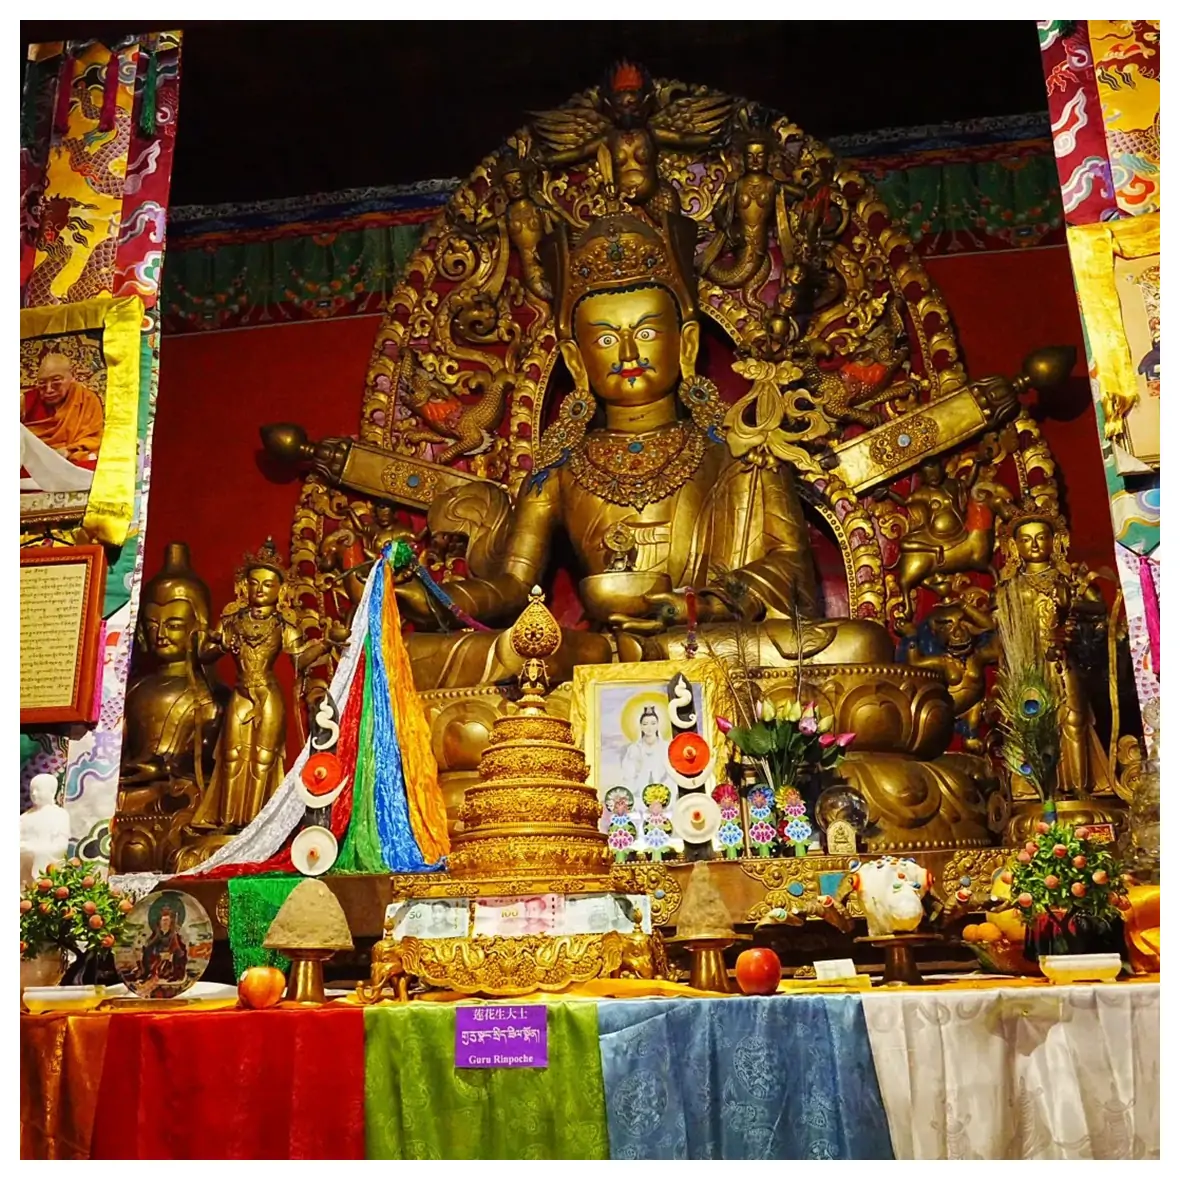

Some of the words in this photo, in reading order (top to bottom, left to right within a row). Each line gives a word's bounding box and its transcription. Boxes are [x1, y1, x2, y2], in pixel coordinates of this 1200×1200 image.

[501, 909, 519, 918] 100
[468, 1054, 491, 1064] Guru
[493, 1053, 534, 1065] Rinpoche
